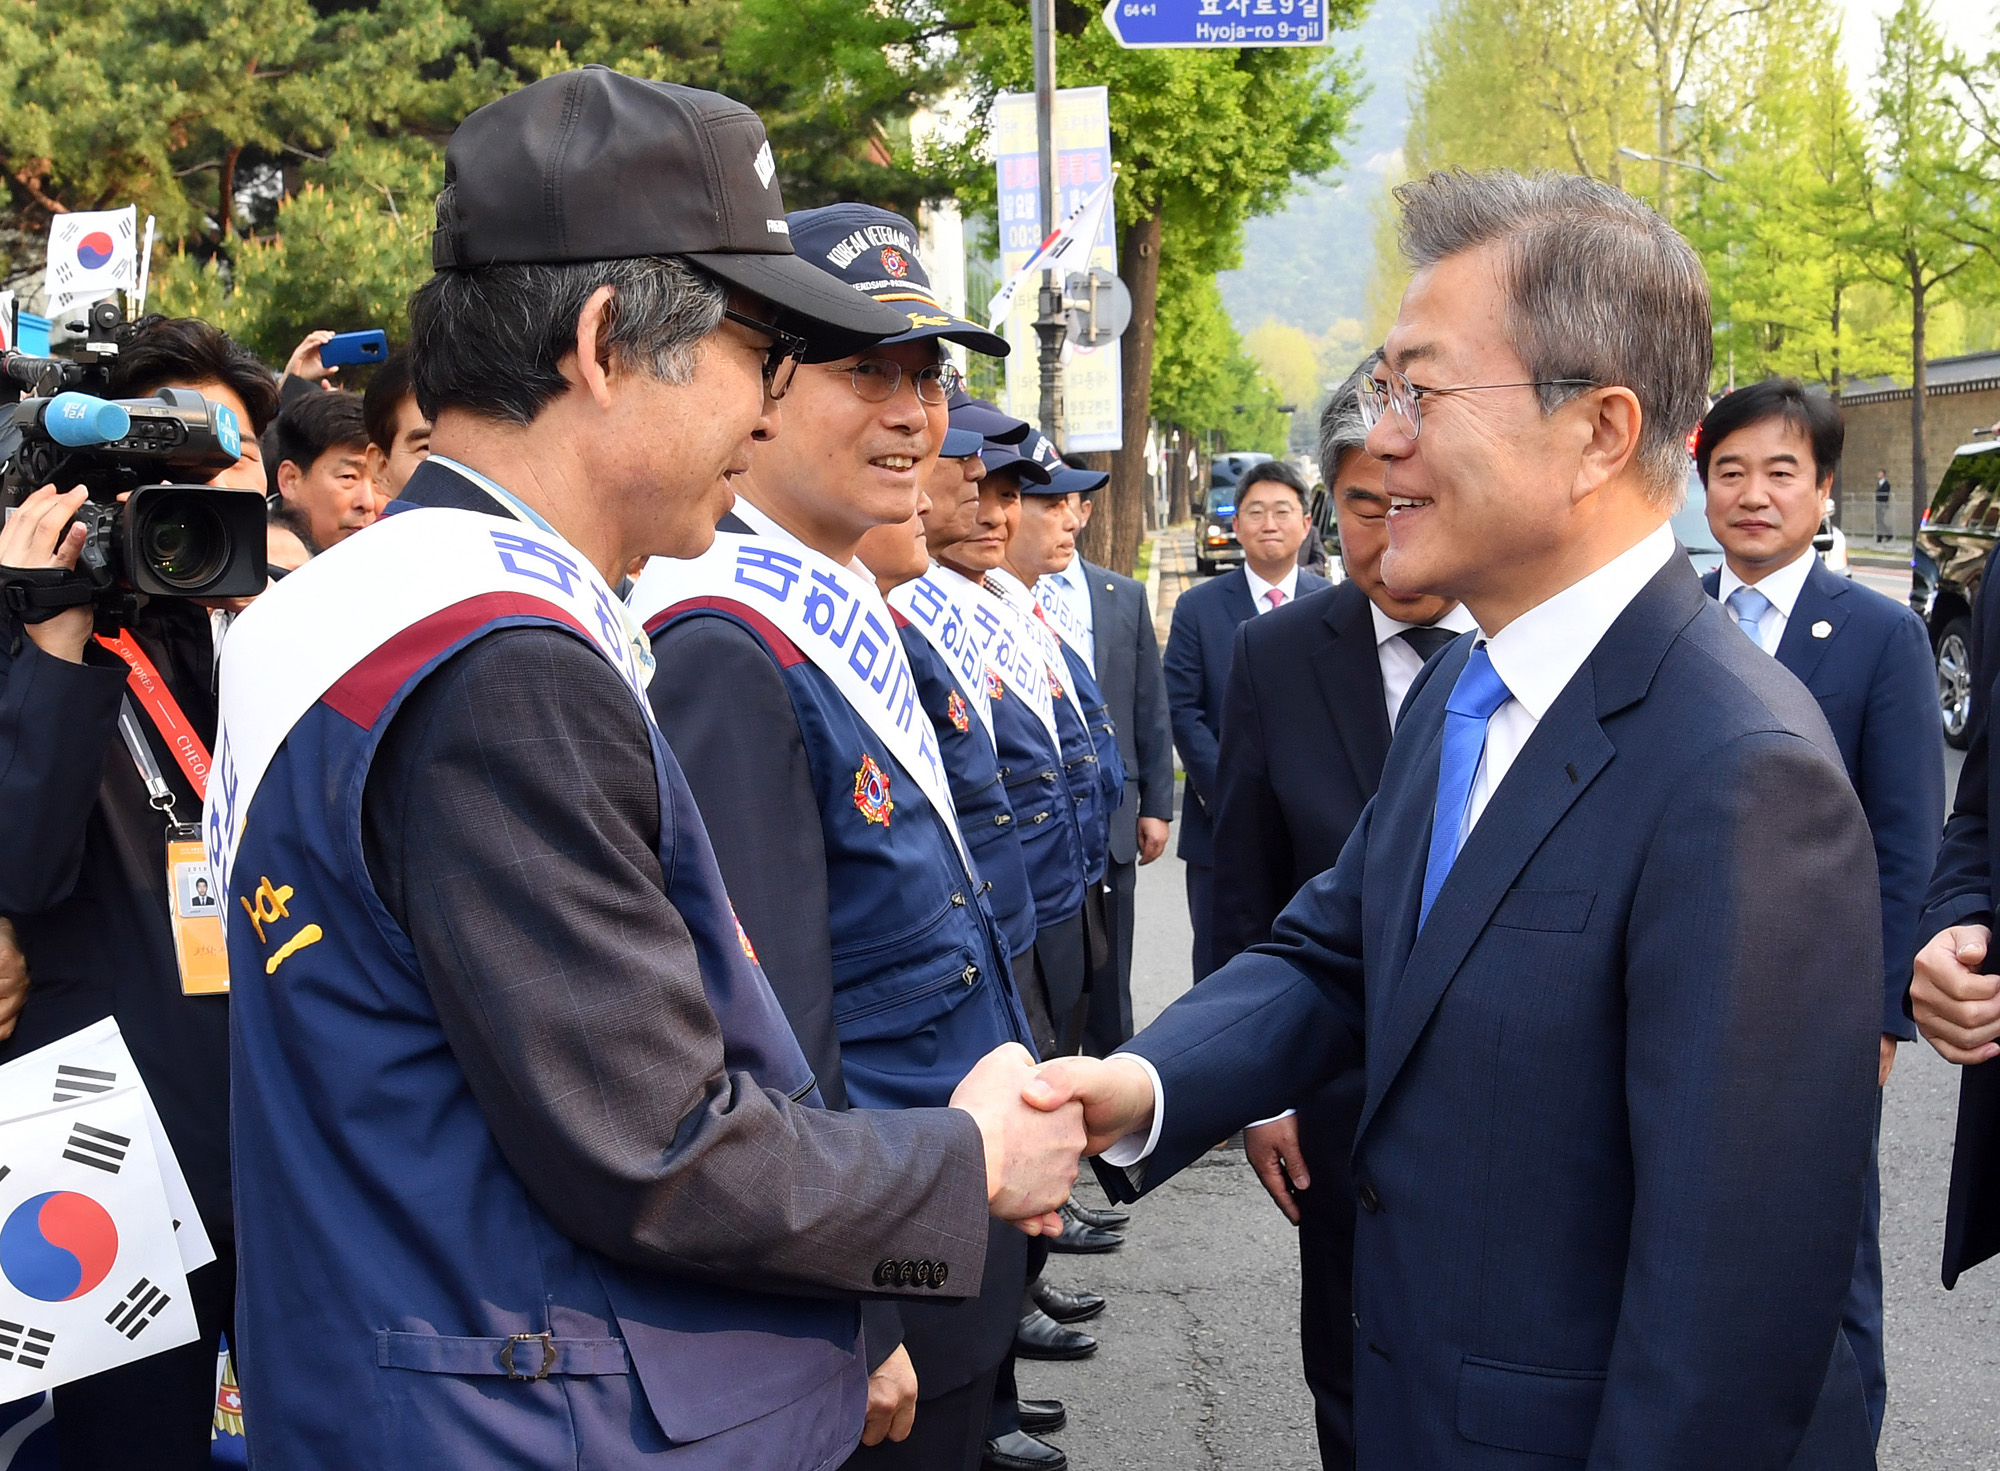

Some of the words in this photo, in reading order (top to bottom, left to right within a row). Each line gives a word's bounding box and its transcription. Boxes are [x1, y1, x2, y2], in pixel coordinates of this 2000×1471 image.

[1196, 22, 1274, 42] Hyoja-ro
[1278, 22, 1319, 42] 9-gil
[826, 230, 871, 270] KOREAN
[863, 225, 912, 254] VETERANS
[120, 645, 133, 661] OF
[129, 660, 156, 694] KOREA
